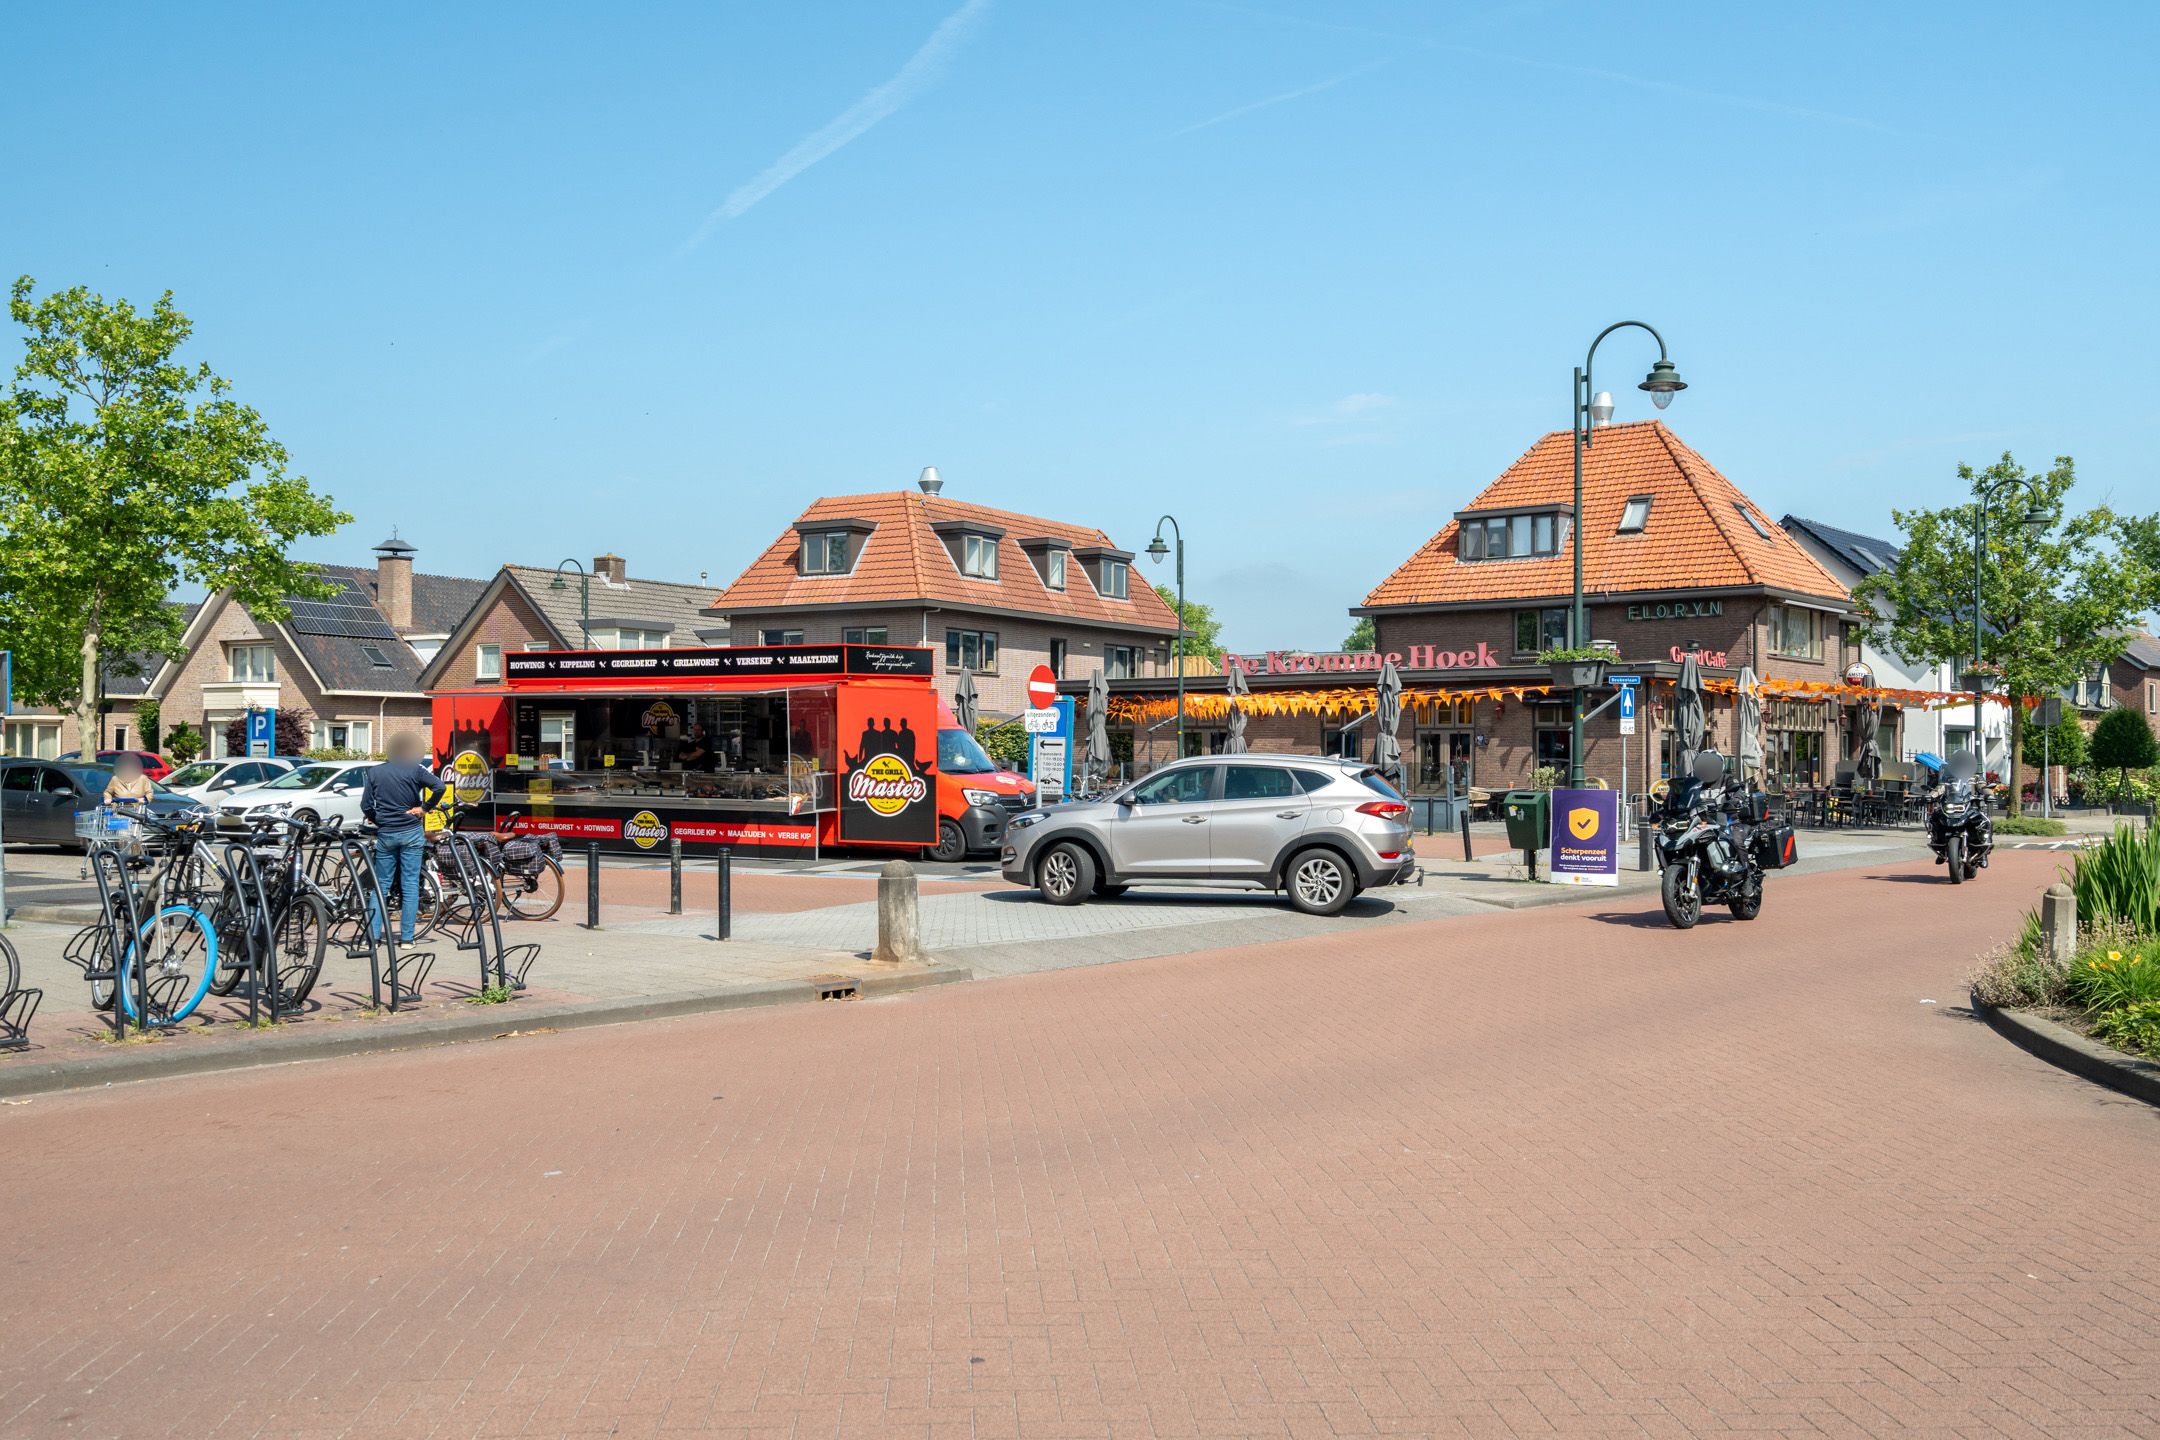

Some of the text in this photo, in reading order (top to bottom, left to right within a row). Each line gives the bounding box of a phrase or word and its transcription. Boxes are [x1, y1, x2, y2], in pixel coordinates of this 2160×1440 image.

[1628, 601, 1722, 619] FLORYN
[736, 657, 773, 666] VERSE KIP
[789, 655, 838, 664] MAALTIJDEN
[1221, 642, 1499, 676] De Kromme Hoek
[1670, 646, 1727, 668] Grd Café
[510, 661, 545, 669] HOTWINGS
[560, 660, 595, 669] KIPPELING
[673, 658, 719, 667] GRILLWORST
[256, 716, 267, 737] P
[853, 773, 922, 797] Master
[538, 823, 573, 831] GRILLWORST
[583, 824, 614, 832] HOTWINGS
[626, 822, 666, 837] Master
[727, 830, 766, 838] MAALTIJDEN
[1561, 847, 1606, 855] Scherpenzeel
